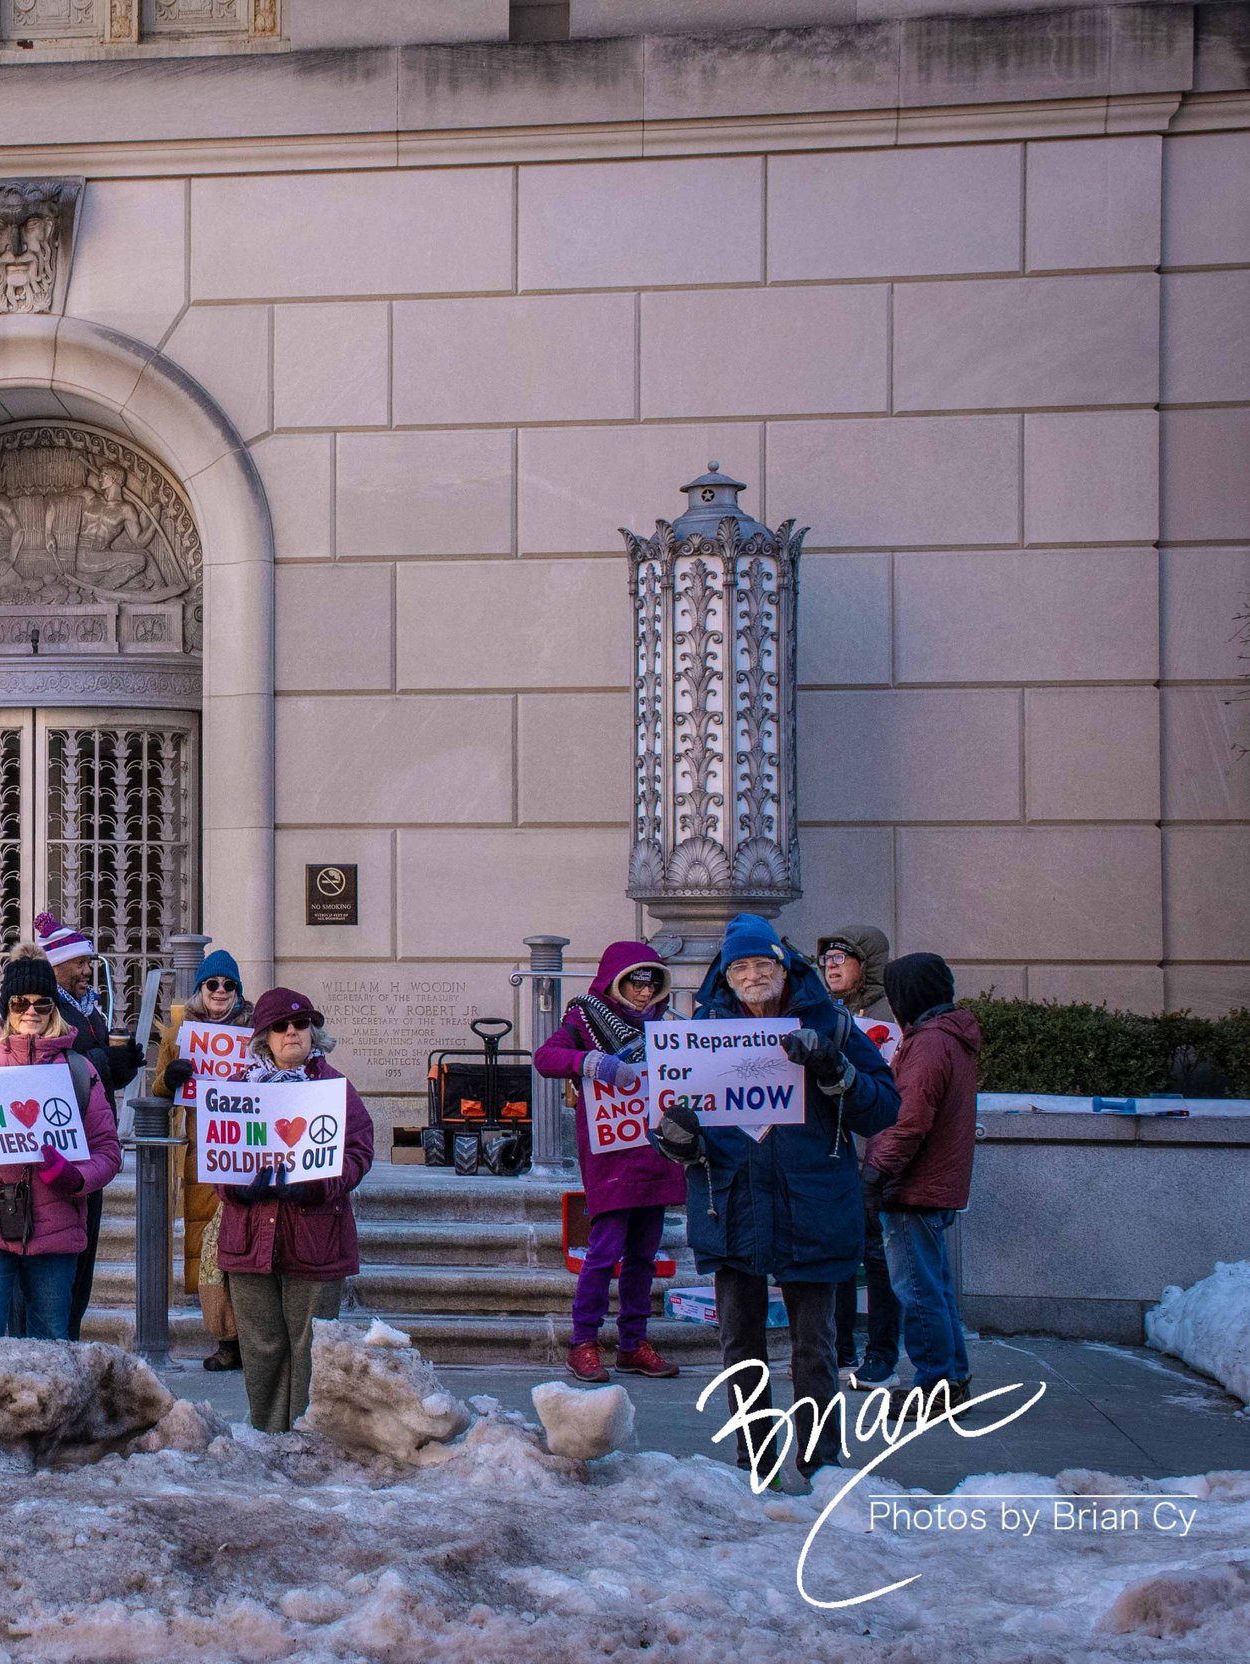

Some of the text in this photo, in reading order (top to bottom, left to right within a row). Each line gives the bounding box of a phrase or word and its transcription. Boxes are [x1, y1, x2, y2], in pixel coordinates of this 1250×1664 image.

[322, 981, 467, 993] WILLIAM H WOODIN
[327, 994, 460, 1002] SECRETARY OF THE TREASURY
[386, 1005, 397, 1016] W
[407, 1005, 456, 1017] ROBERT
[462, 1005, 480, 1017] JR
[351, 1017, 398, 1026] SECRETARY
[403, 1018, 414, 1026] OF
[419, 1018, 436, 1026] THE
[352, 1028, 436, 1037] JAMES A WETMORE
[358, 1038, 413, 1046] SUPERVISING
[417, 1038, 467, 1046] ARCHITECT
[654, 1033, 680, 1050] US
[353, 1049, 383, 1057] RITTER
[388, 1049, 408, 1057] AND
[367, 1058, 421, 1066] ARCHITECTS
[658, 1064, 692, 1081] for
[205, 1087, 261, 1114] Gaza:
[658, 1085, 794, 1113] Gaza NOW
[205, 1119, 267, 1146] AID IN
[43, 1128, 78, 1151] OUT
[206, 1145, 338, 1174] SOLDIERS OUT
